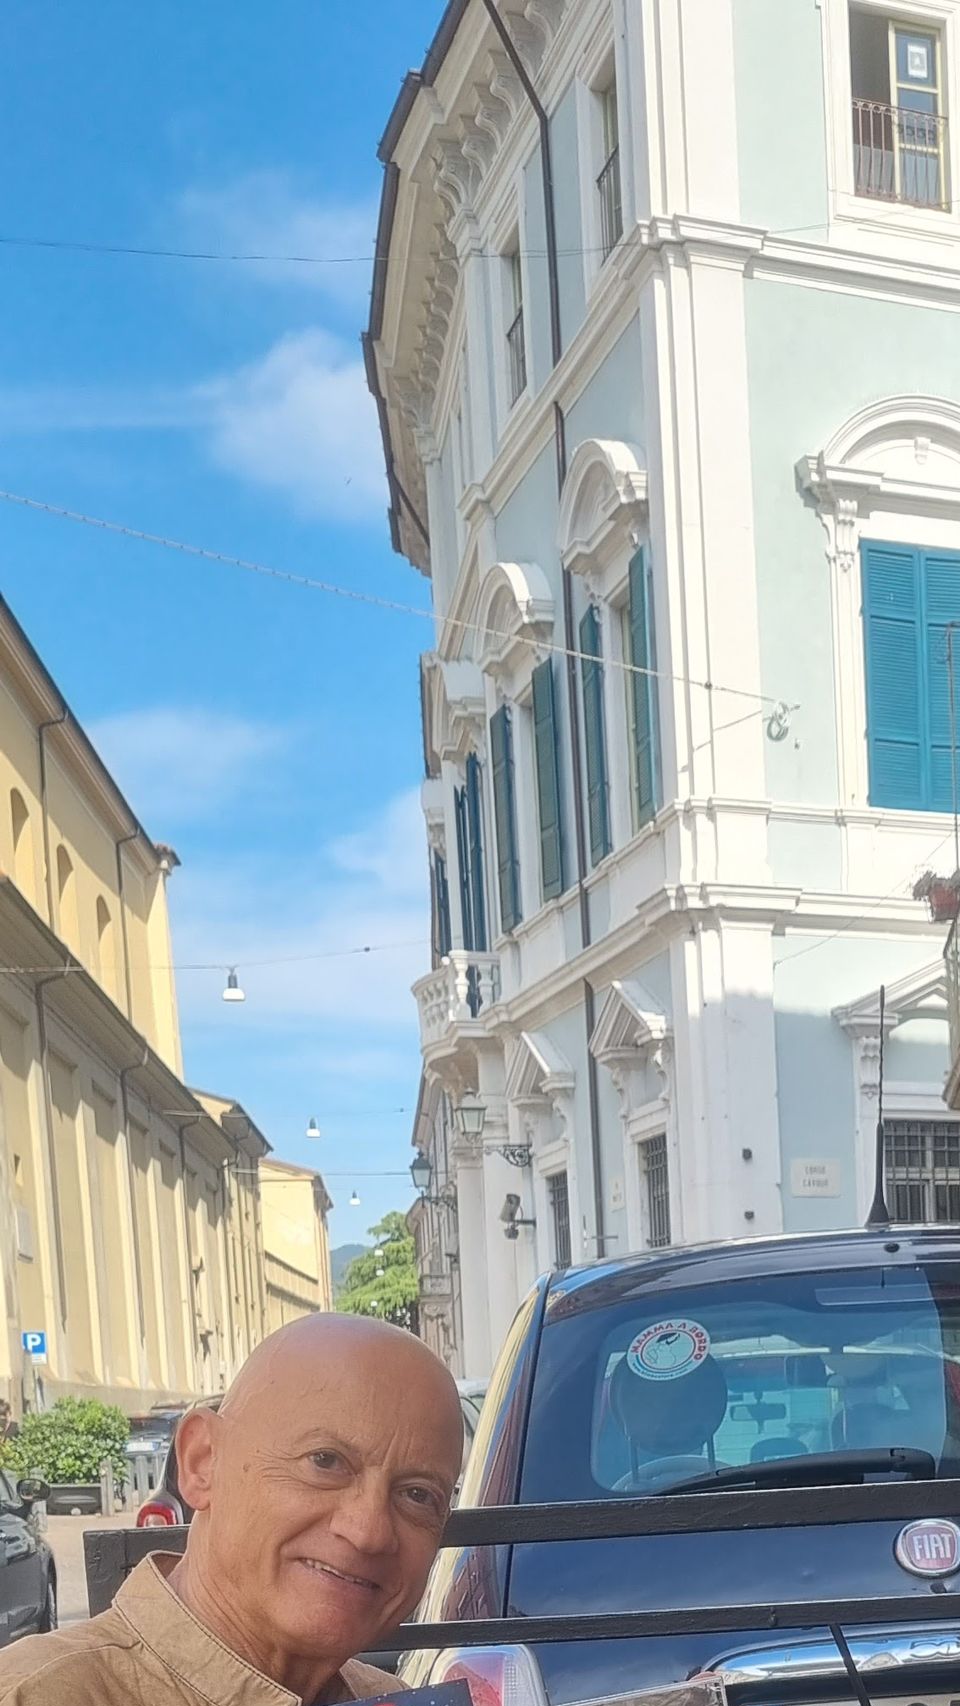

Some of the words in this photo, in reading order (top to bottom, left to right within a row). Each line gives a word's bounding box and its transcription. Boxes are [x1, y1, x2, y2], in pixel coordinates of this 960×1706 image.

[26, 1333, 42, 1351] P
[630, 1322, 674, 1354] MAMMA
[689, 1325, 707, 1361] BORDO
[912, 1532, 954, 1561] FIAT
